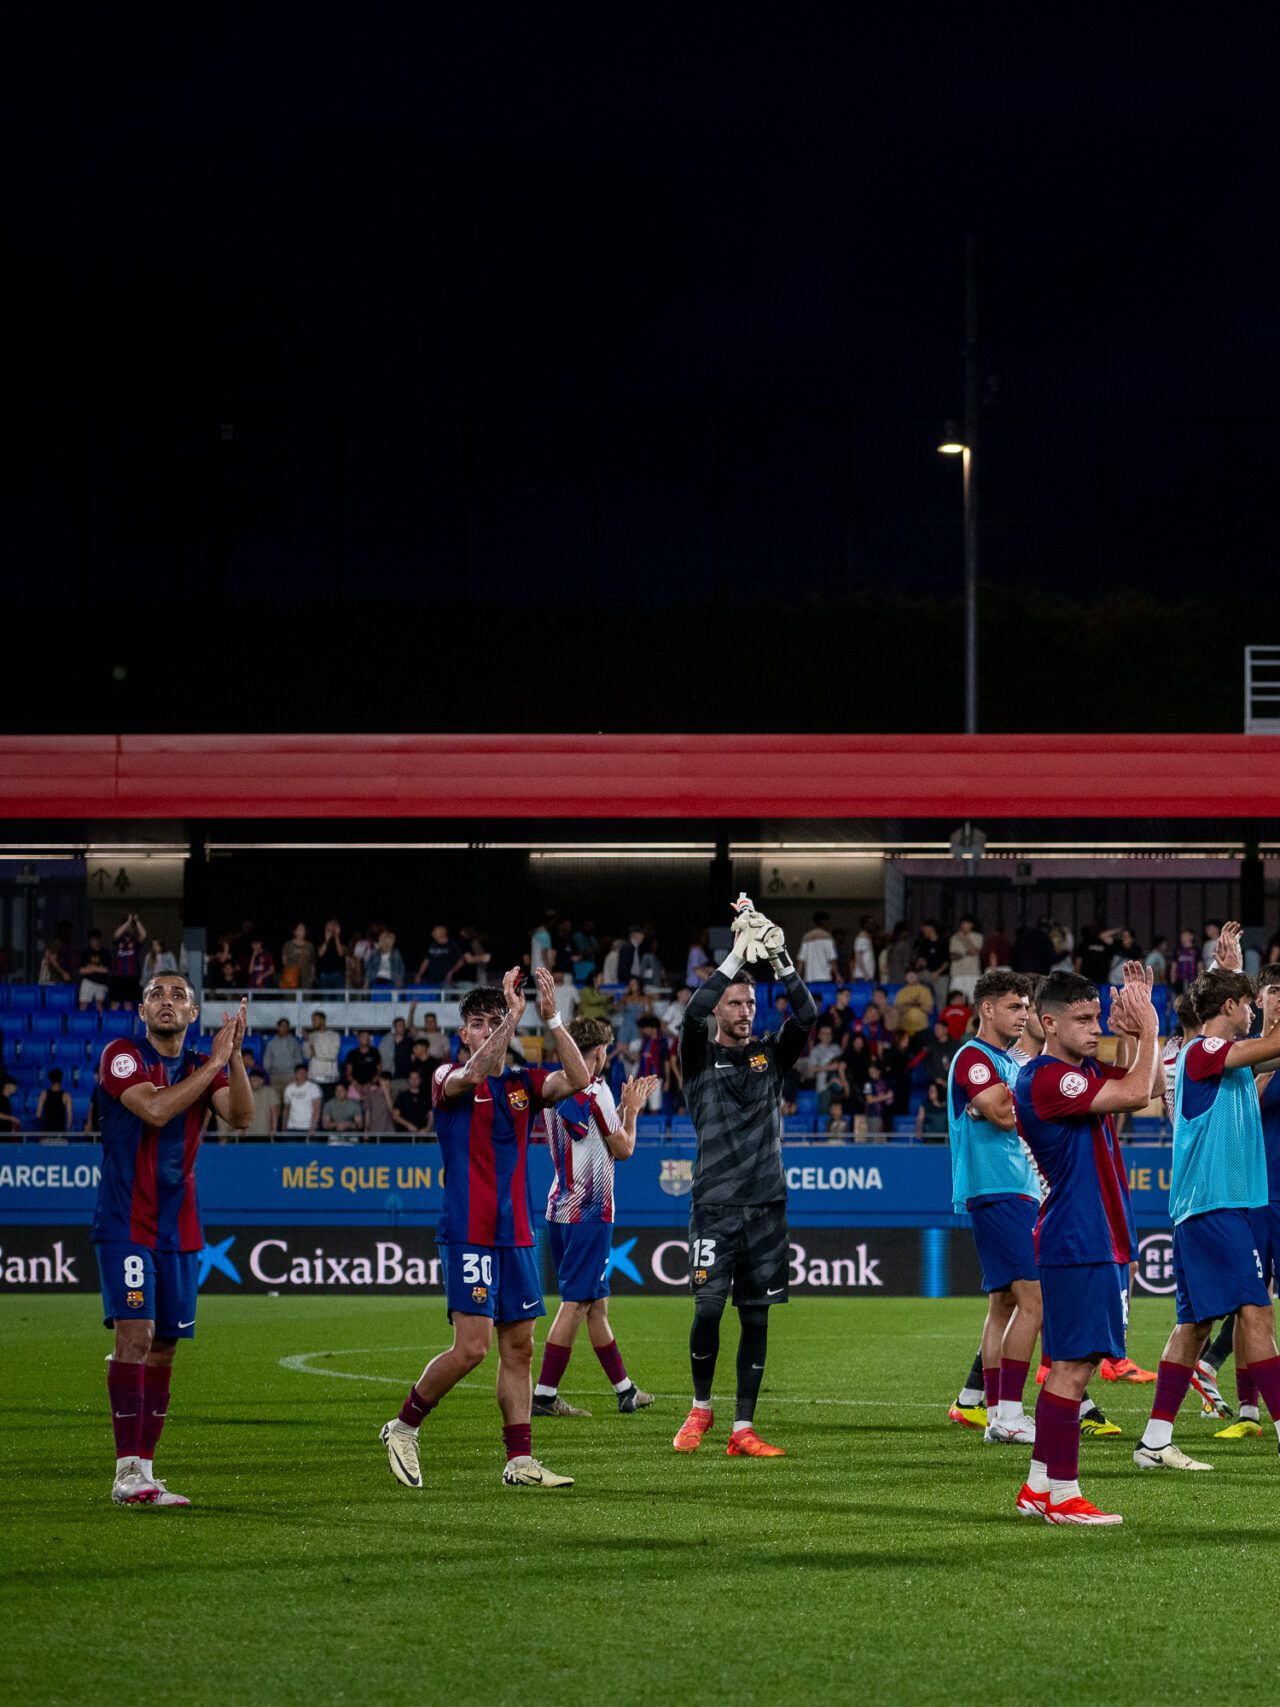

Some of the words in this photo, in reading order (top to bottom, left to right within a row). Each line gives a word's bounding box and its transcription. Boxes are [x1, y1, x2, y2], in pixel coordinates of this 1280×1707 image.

[282, 1161, 334, 1189] MÉS
[341, 1167, 390, 1193] QUE
[397, 1167, 431, 1189] UN
[787, 1167, 883, 1190] CELONA
[0, 1241, 79, 1284] ank
[693, 1238, 716, 1267] 13
[124, 1255, 144, 1288] 8
[462, 1254, 492, 1286] 30
